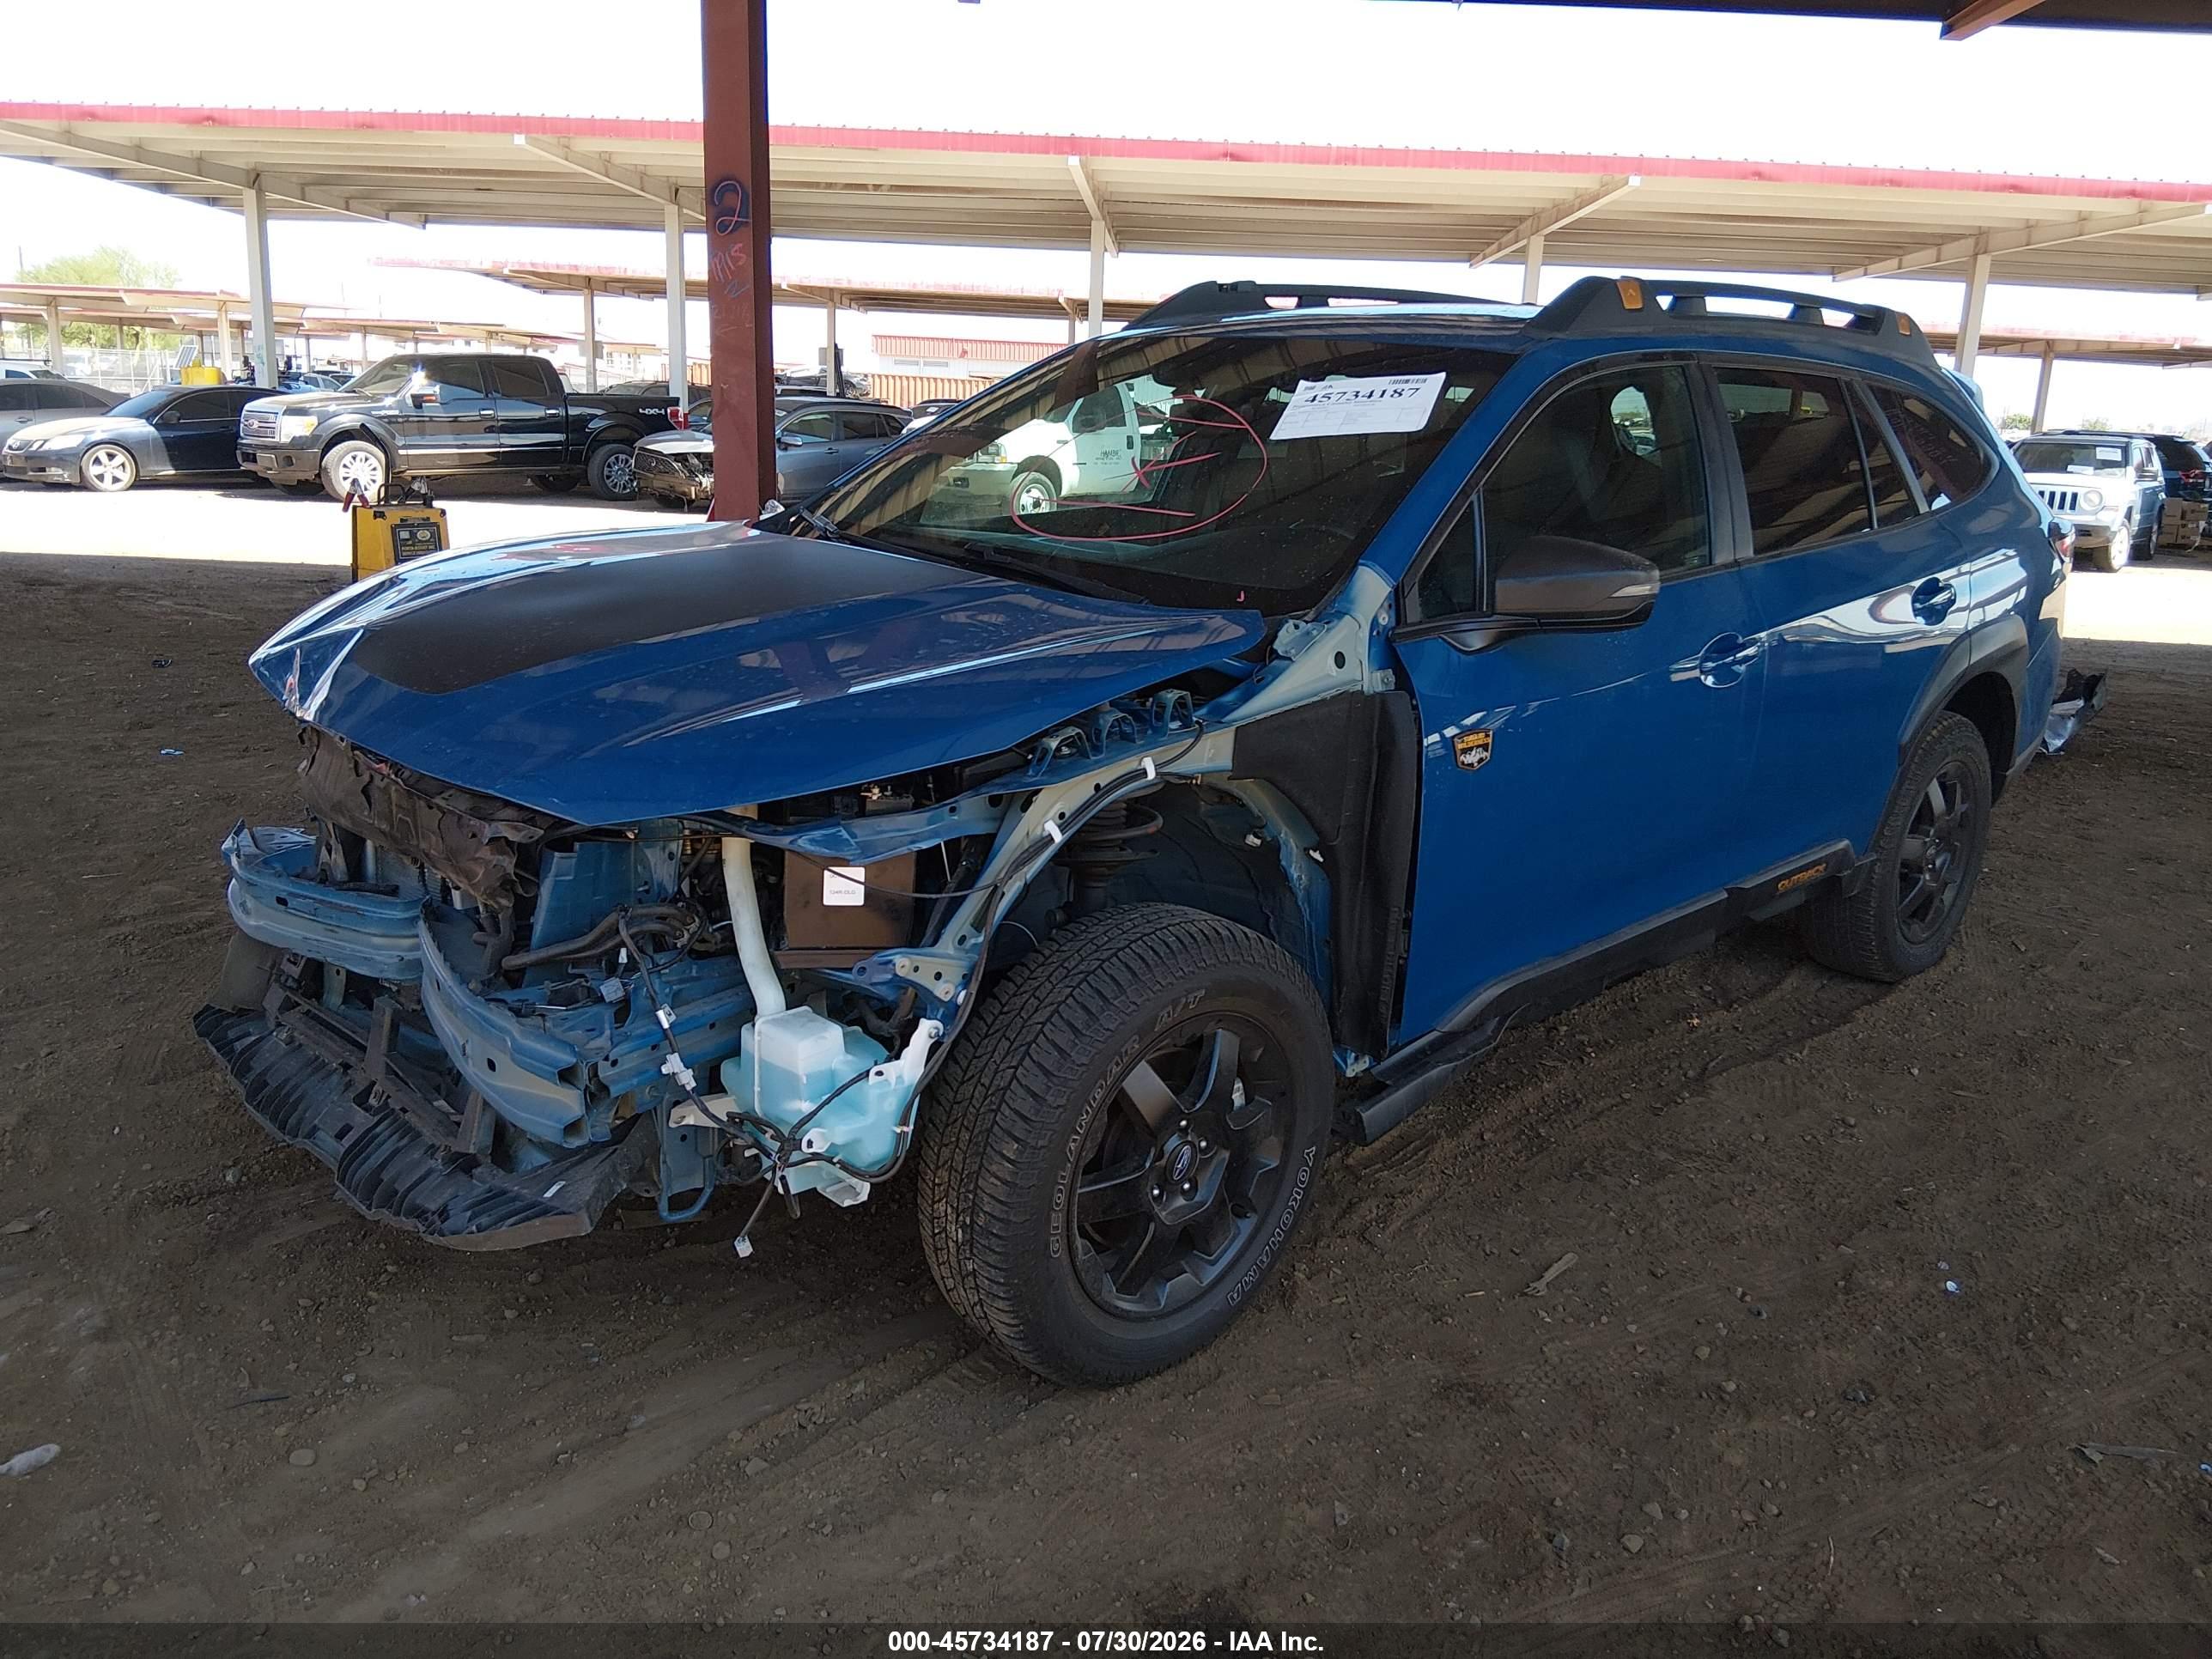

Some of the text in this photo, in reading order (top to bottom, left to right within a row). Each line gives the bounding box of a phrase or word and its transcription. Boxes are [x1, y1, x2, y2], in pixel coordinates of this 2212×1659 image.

[713, 179, 751, 236] 2
[1305, 387, 1421, 404] 45734187
[1778, 863, 1826, 891] OUTBACK
[1155, 989, 1206, 1031] A/T
[1050, 1034, 1140, 1258] GEOLANDAR
[1227, 1146, 1316, 1306] YOKOHAMA
